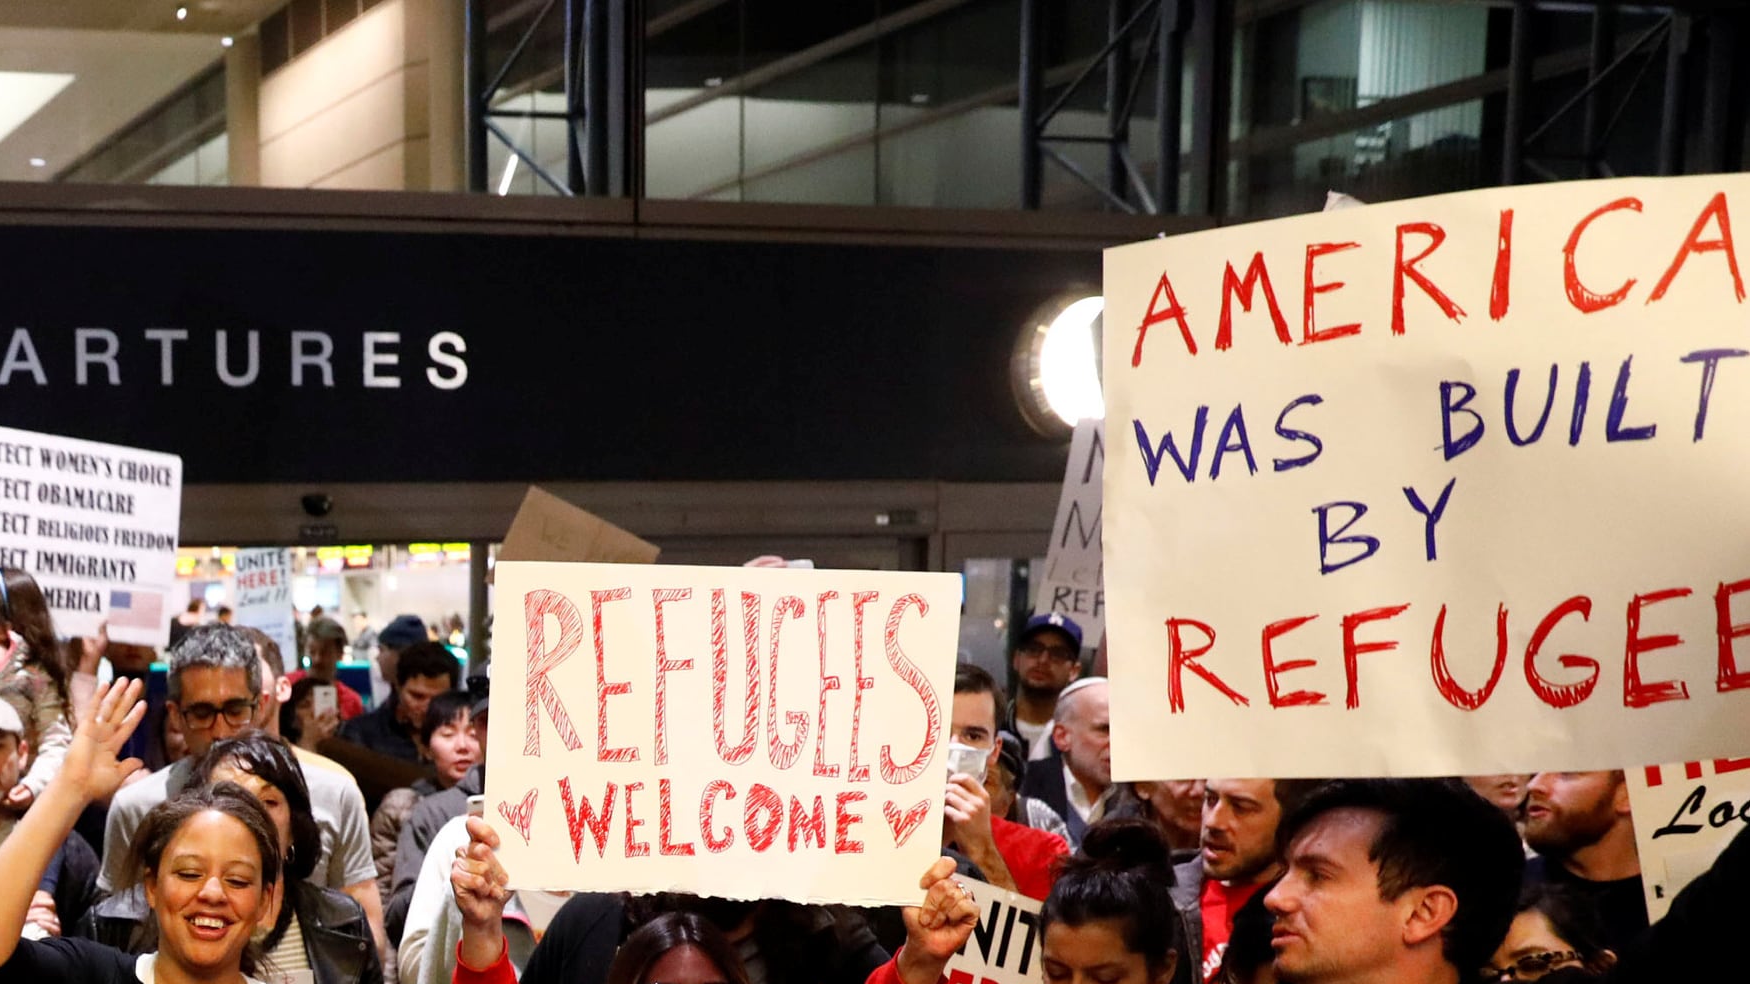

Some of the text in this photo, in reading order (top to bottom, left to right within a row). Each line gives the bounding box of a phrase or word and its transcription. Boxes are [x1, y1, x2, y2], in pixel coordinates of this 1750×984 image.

[1132, 192, 1750, 368] AMERICA
[1132, 395, 1326, 486] WAS
[1434, 348, 1750, 462] BUILT
[40, 447, 112, 478] WOMEN'S
[118, 459, 173, 488] CHOICE
[37, 482, 135, 516] OBAMACARE
[1312, 478, 1457, 575] BY
[36, 518, 110, 546] RELIGIOUS
[113, 527, 175, 552] FREEDOM
[236, 551, 286, 573] UNITE
[36, 551, 137, 582] IMMIGRANTS
[237, 568, 286, 591] HERE!
[43, 584, 101, 613] MERICA
[1165, 578, 1750, 714] REFUGEE
[522, 586, 943, 785] REFUGEES
[558, 776, 869, 864] WELCOME
[950, 900, 1042, 976] NIT
